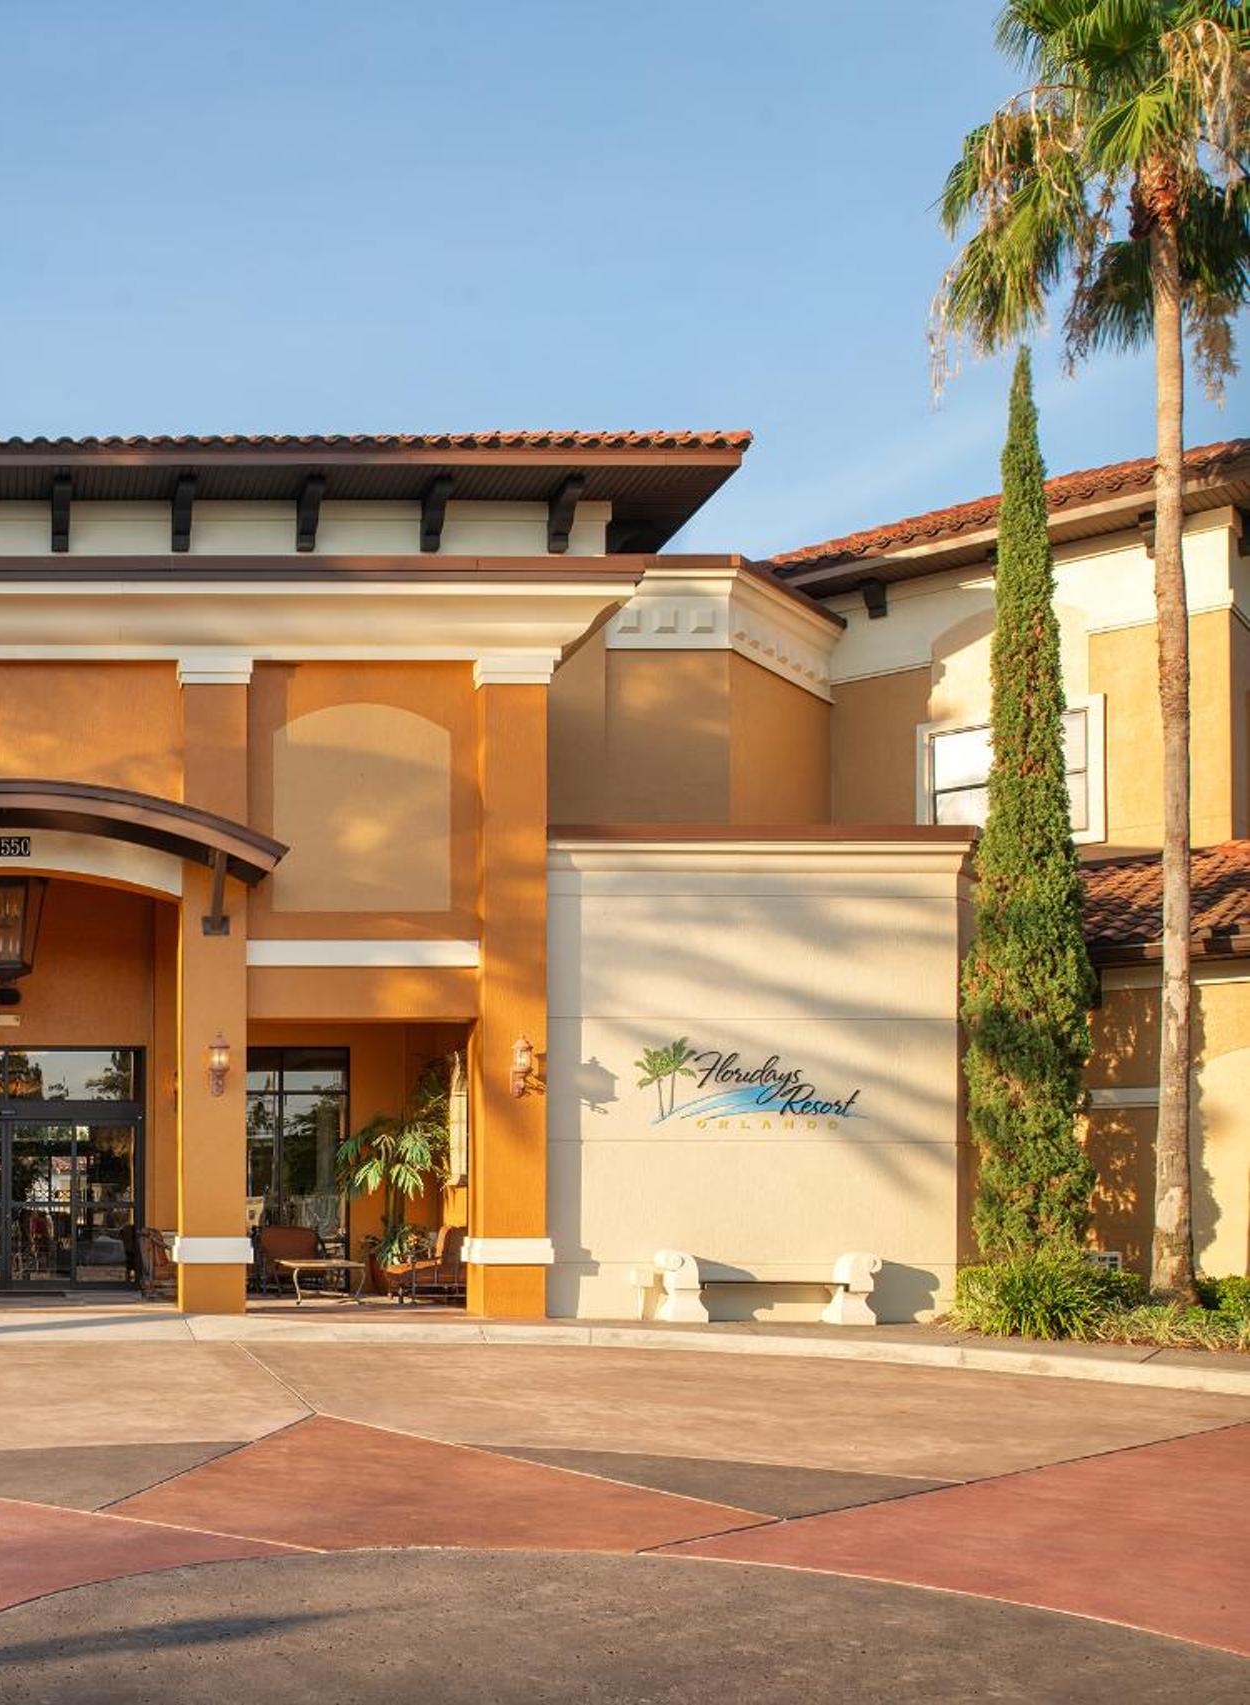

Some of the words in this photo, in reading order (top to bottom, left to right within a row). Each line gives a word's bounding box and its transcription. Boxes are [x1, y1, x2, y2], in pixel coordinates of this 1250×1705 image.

[694, 1051, 803, 1104] Floridays
[780, 1083, 860, 1116] Resort
[695, 1119, 839, 1131] ORLANDO
